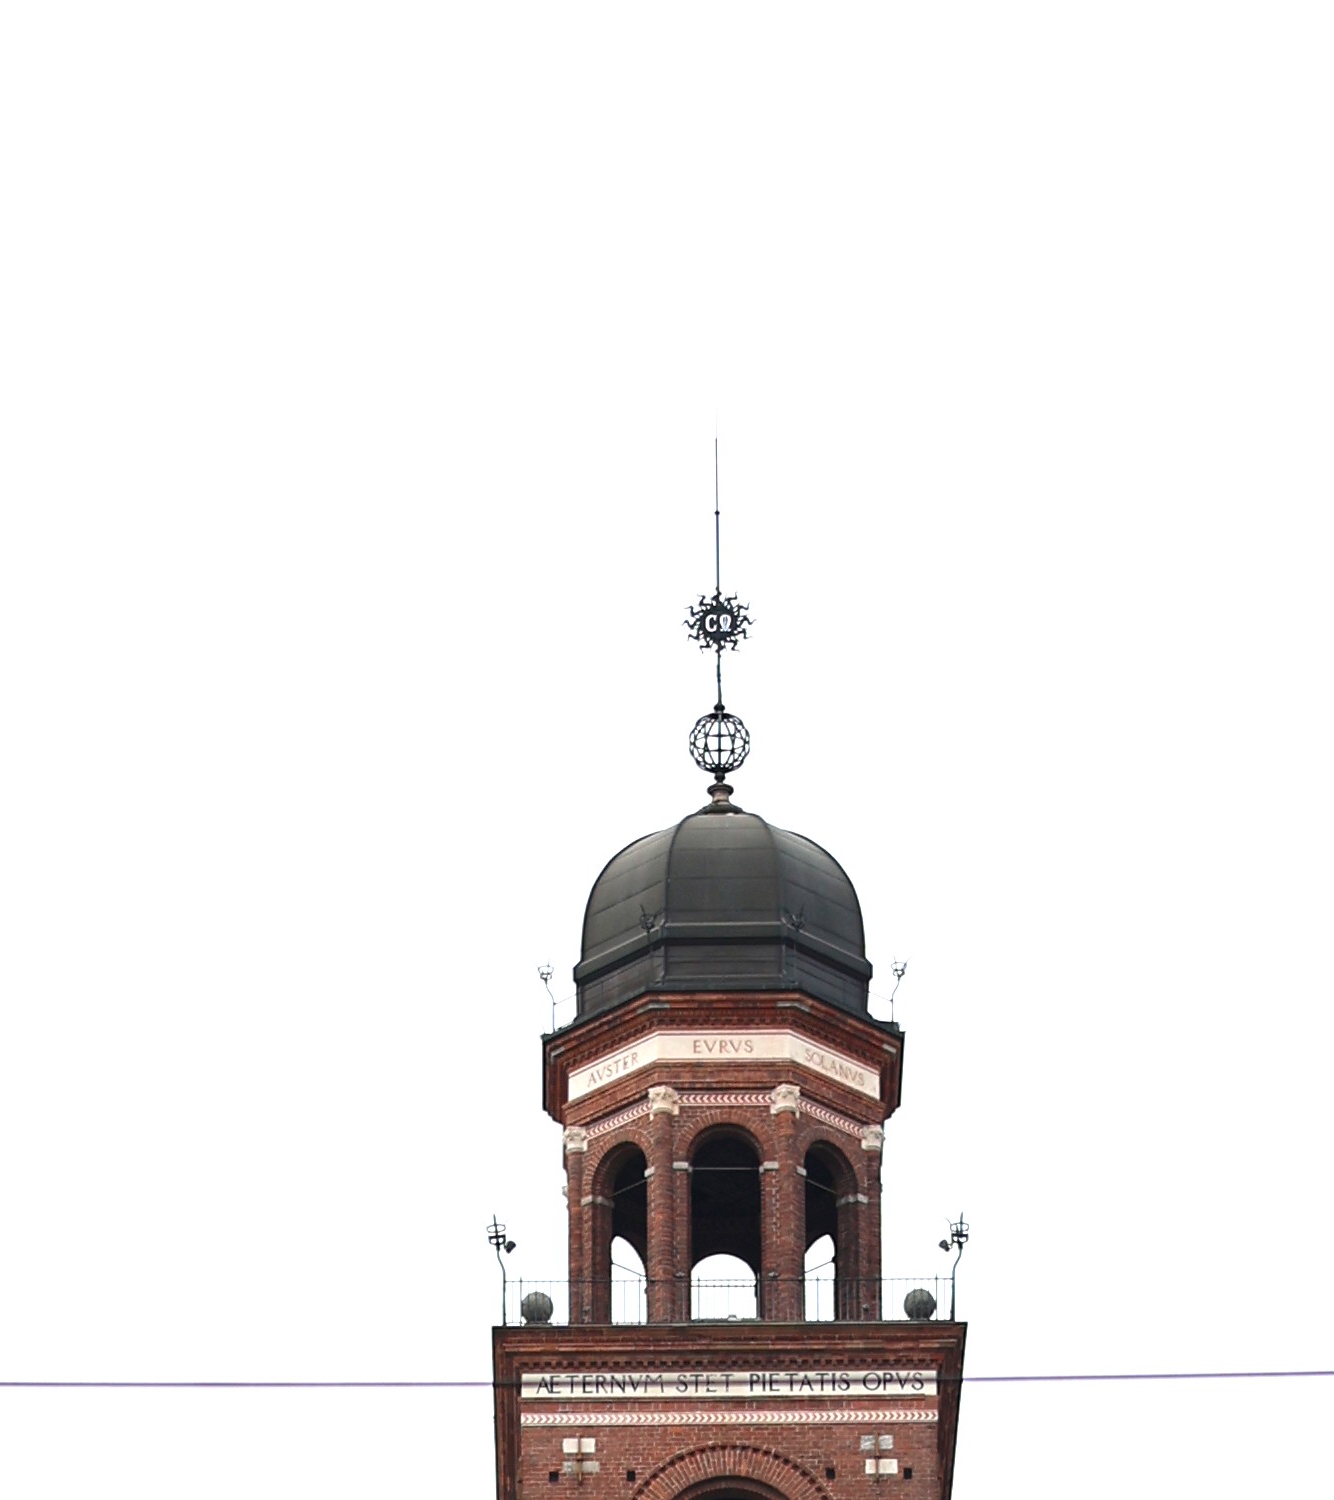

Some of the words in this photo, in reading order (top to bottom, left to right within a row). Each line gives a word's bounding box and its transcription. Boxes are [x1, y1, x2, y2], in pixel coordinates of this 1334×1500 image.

[693, 1039, 755, 1054] EVRVS
[586, 1051, 639, 1088] AVSTER
[804, 1049, 866, 1087] SOLANVS
[675, 1374, 735, 1393] STET
[749, 1373, 851, 1392] PIETATIS
[862, 1372, 925, 1391] OPVS
